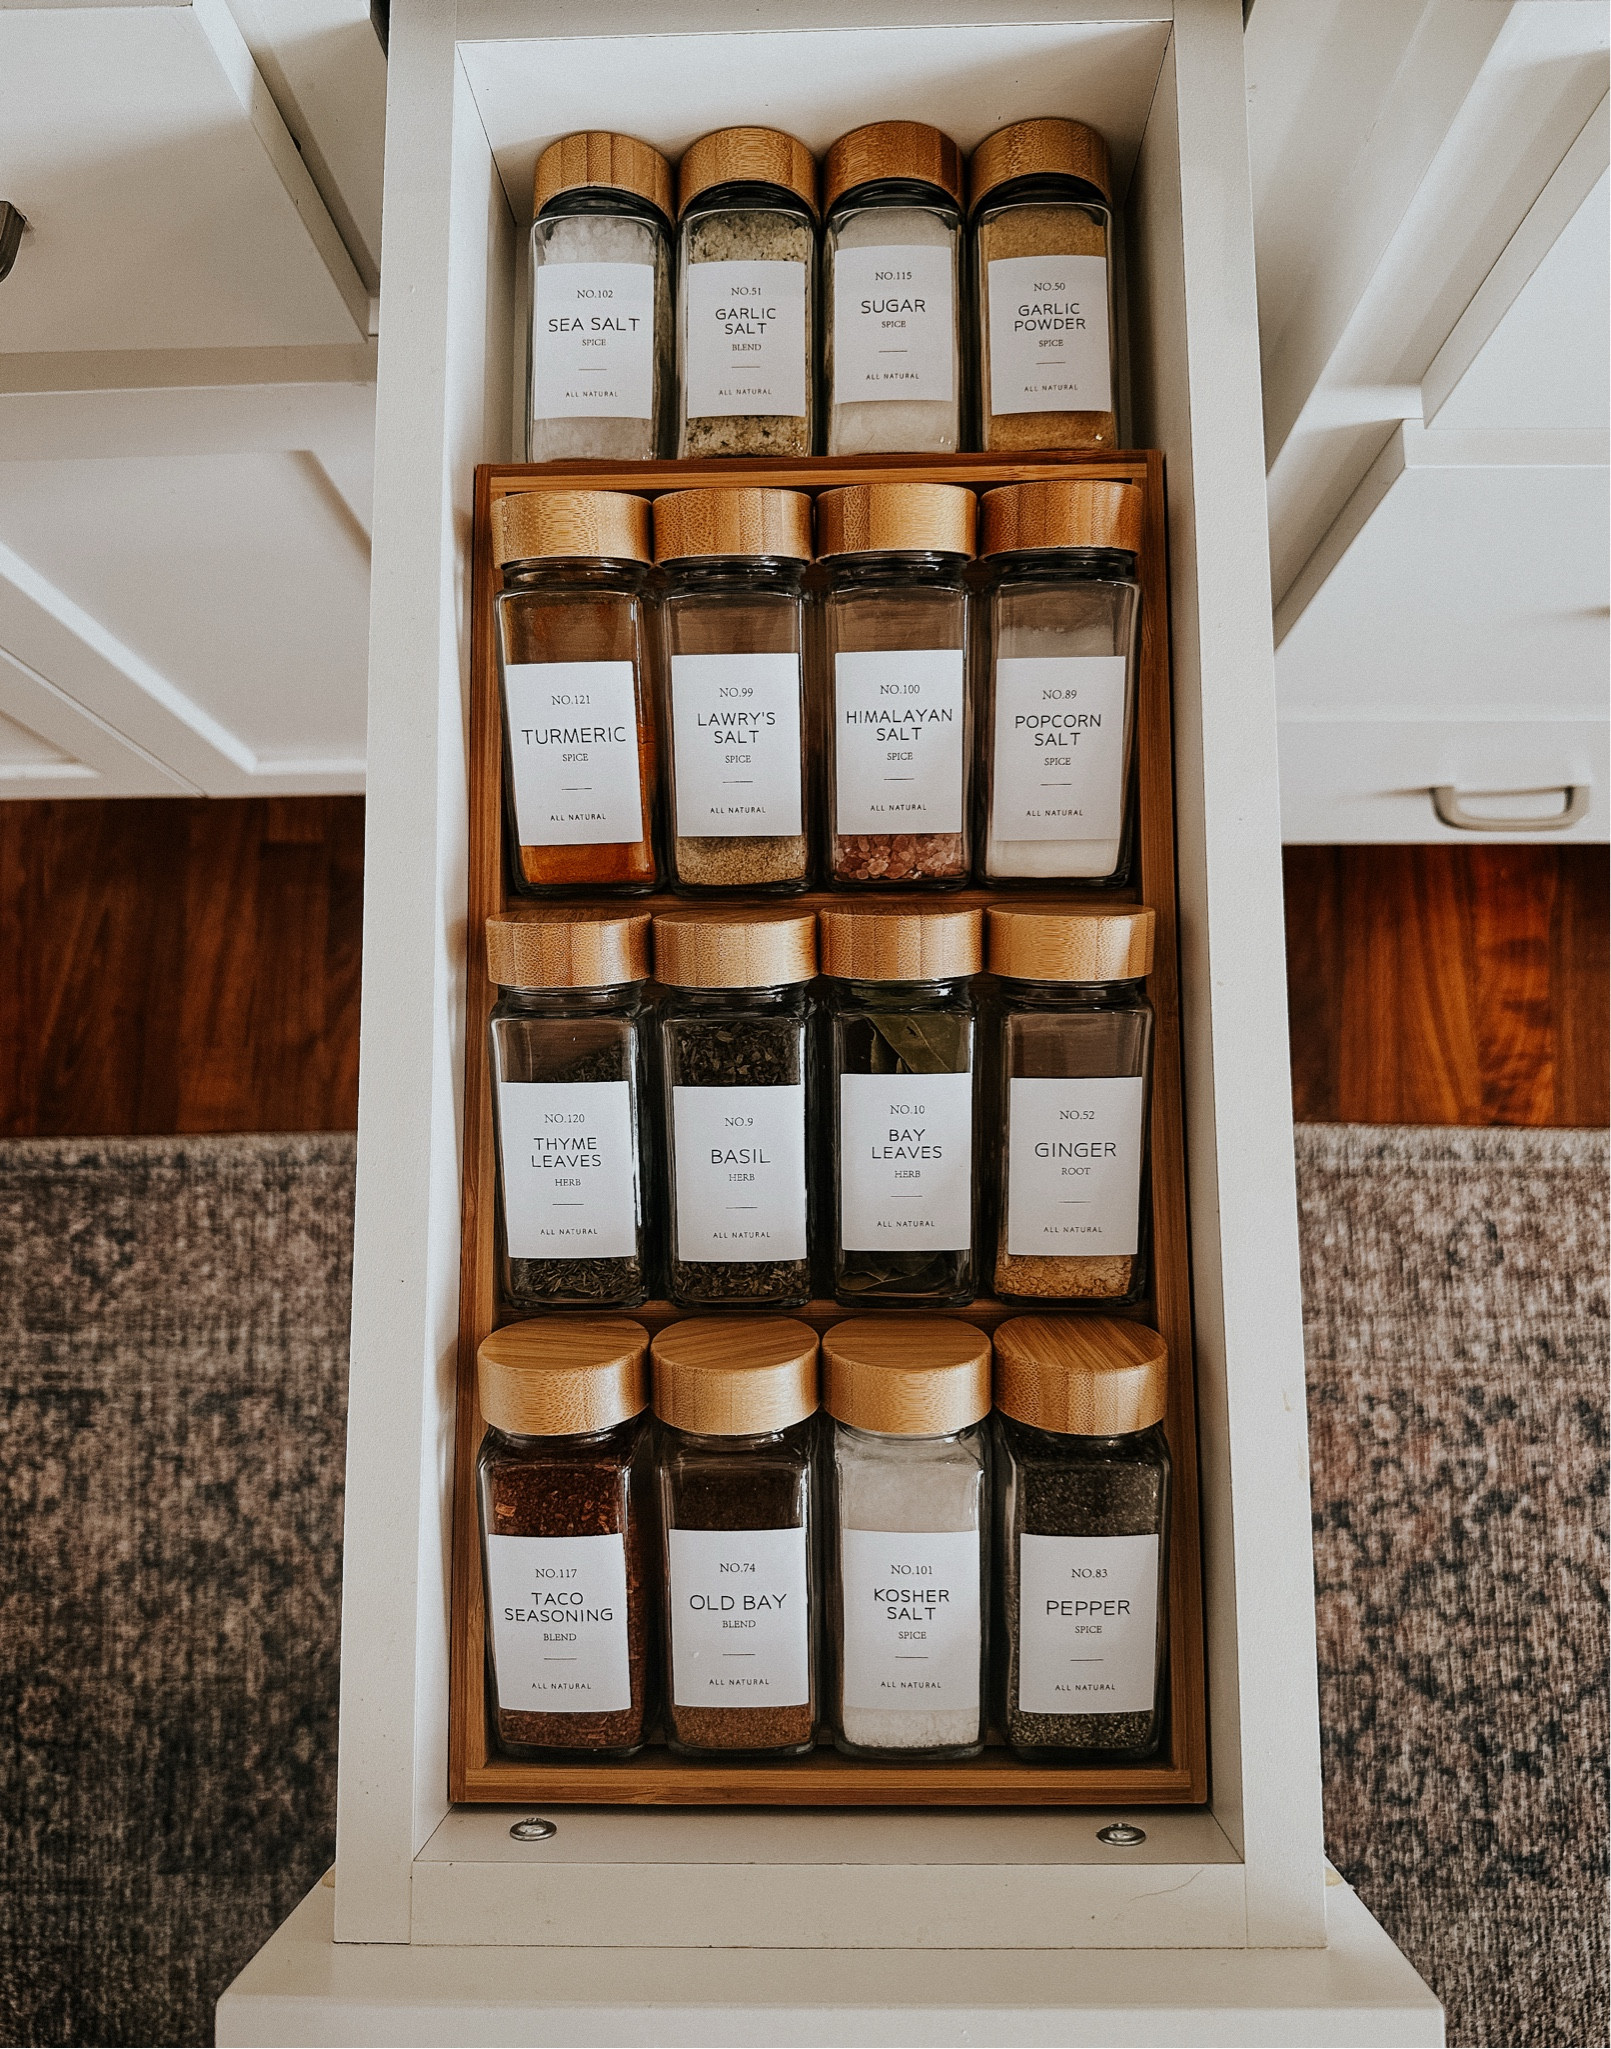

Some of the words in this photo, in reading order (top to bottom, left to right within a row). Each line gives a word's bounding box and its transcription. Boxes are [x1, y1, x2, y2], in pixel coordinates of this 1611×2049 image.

[875, 272, 912, 280] NO.115
[731, 287, 760, 295] NO.51
[1034, 283, 1065, 291] NO.50
[577, 290, 613, 298] NO.102
[861, 299, 925, 314] SUGAR
[1018, 303, 1079, 316] GARLIC
[716, 308, 775, 320] GARLIC
[549, 318, 584, 332] SEA
[591, 318, 640, 331] SALT
[725, 323, 767, 334] SALT
[1015, 318, 1086, 331] POWDER
[1039, 339, 1064, 347] SPICE
[865, 373, 881, 381] ALL
[883, 372, 920, 380] NATURAL
[1024, 385, 1038, 393] ALL
[1041, 383, 1079, 391] NATURAL
[582, 390, 618, 398] NATURAL
[720, 688, 753, 697] NO.99
[880, 685, 920, 694] NO.100
[1043, 690, 1077, 699] NO.89
[552, 695, 590, 705] NO.121
[698, 712, 775, 726] LAWRY'S
[847, 709, 952, 723] HIMALAYAN
[1016, 714, 1101, 728] POPCORN
[521, 727, 626, 744] TURMERIC
[715, 731, 759, 743] SALT
[877, 727, 922, 741] SALT
[1035, 732, 1080, 746] SALT
[563, 753, 588, 761] SPICE
[725, 755, 751, 763] SPICE
[887, 752, 913, 760] SPICE
[1044, 758, 1071, 766] SPICE
[710, 807, 725, 815] ALL
[728, 806, 766, 814] NATURAL
[870, 804, 886, 812] ALL
[888, 803, 927, 811] NATURAL
[550, 814, 565, 822] ALL
[568, 813, 607, 821] NATURAL
[1044, 809, 1083, 817] NATURAL
[890, 1105, 924, 1114] NO.10
[545, 1114, 584, 1123] NO.120
[1060, 1111, 1094, 1119] NO.52
[725, 1117, 753, 1126] NO.9
[889, 1129, 925, 1141] BAY
[534, 1138, 597, 1150] THYME
[872, 1146, 942, 1159] LEAVES
[1035, 1143, 1116, 1157] GINGER
[532, 1155, 601, 1167] LEAVES
[712, 1149, 770, 1164] BASIL
[895, 1170, 920, 1178] HERB
[1062, 1167, 1091, 1175] ROOT
[876, 1220, 893, 1228] ALL
[895, 1220, 935, 1228] NATURAL
[540, 1228, 556, 1236] ALL
[558, 1228, 598, 1236] NATURAL
[1043, 1226, 1059, 1234] ALL
[1062, 1226, 1103, 1234] NATURAL
[731, 1231, 771, 1239] NATURAL
[720, 1563, 755, 1572] NO.74
[891, 1565, 932, 1574] NO.101
[536, 1569, 577, 1578] NO.117
[1072, 1569, 1107, 1578] NO.83
[531, 1592, 583, 1605] TACO
[874, 1589, 949, 1602] KOSHER
[690, 1595, 734, 1610] OLD
[744, 1594, 787, 1610] BAY
[1047, 1600, 1130, 1615] PEPPER
[505, 1608, 612, 1622] SEASONING
[887, 1607, 936, 1620] SALT
[723, 1620, 756, 1628] BLEND
[544, 1633, 576, 1641] BLEND
[899, 1631, 926, 1639] SPICE
[531, 1682, 548, 1690] ALL
[550, 1682, 592, 1690] NATURAL
[708, 1678, 725, 1686] ALL
[728, 1678, 770, 1686] NATURAL
[900, 1681, 942, 1689] NATURAL
[1054, 1684, 1072, 1692] ALL
[1074, 1683, 1116, 1691] NATURAL
